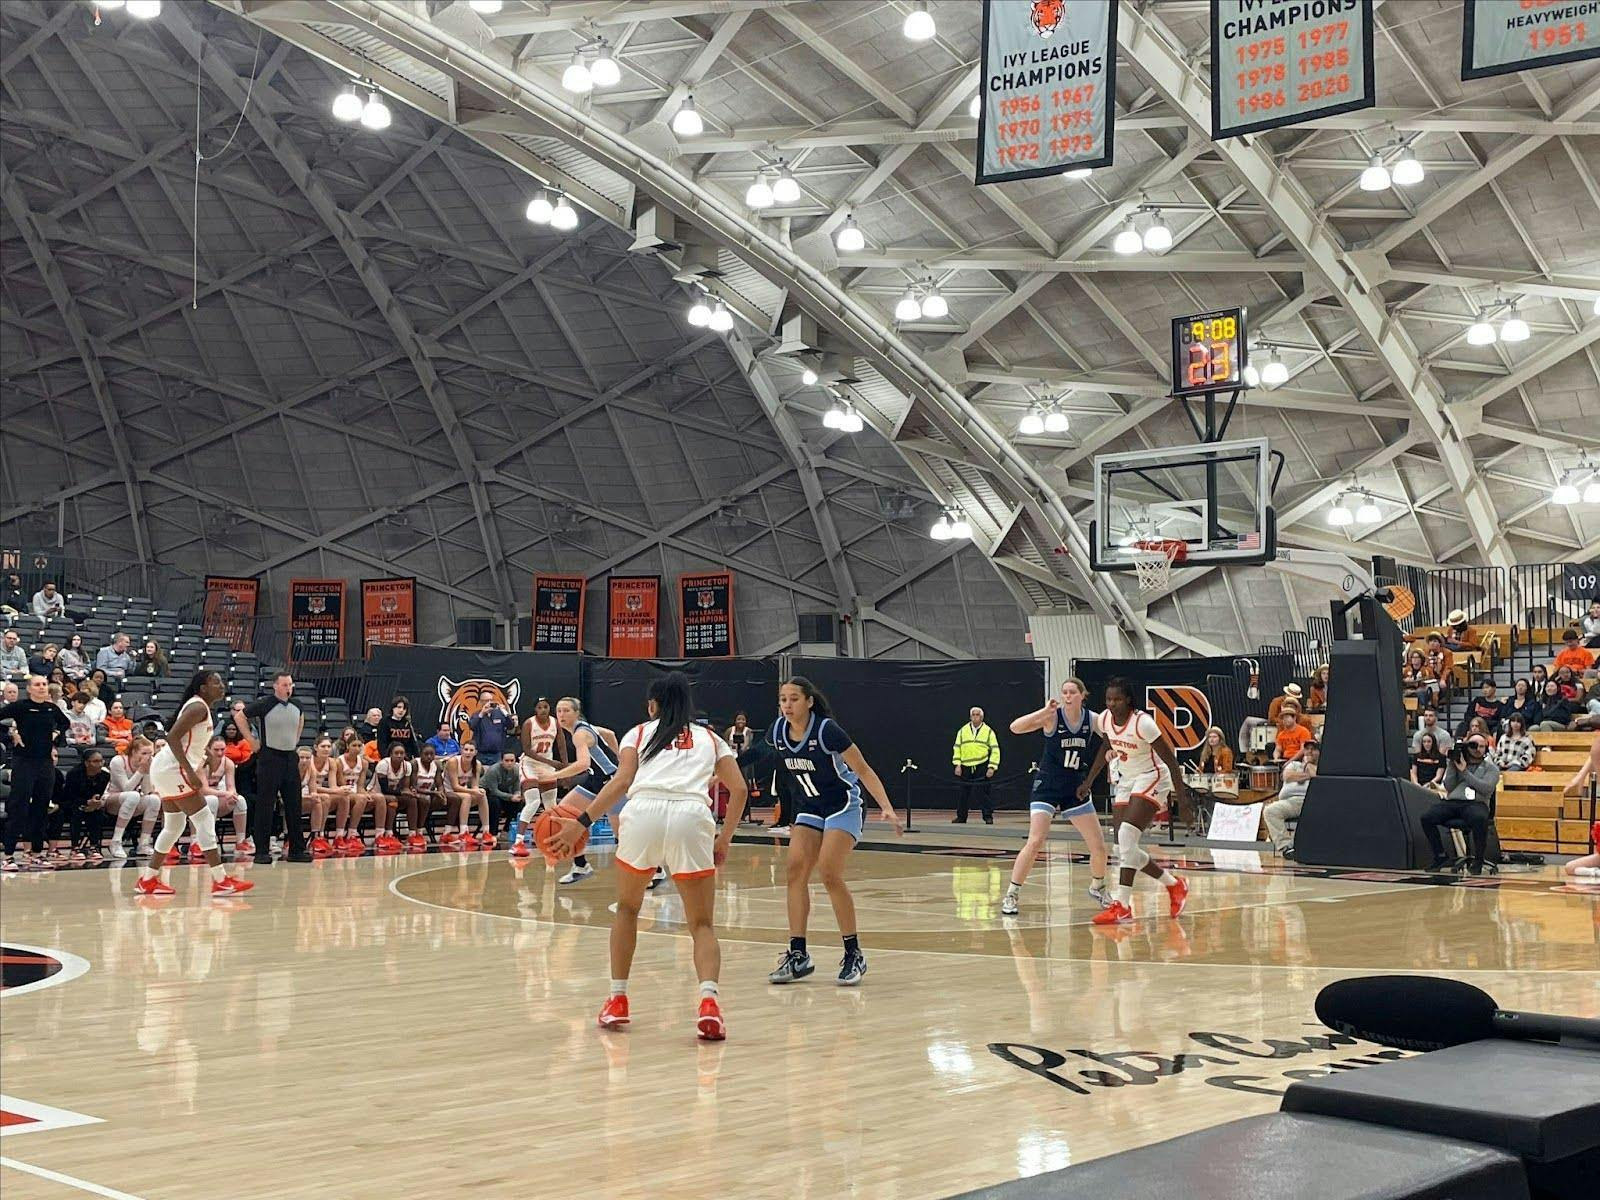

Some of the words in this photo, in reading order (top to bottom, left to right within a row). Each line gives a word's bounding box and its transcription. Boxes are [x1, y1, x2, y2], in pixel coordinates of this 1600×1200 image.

[1224, 0, 1356, 39] CHAMPIONS
[1506, 2, 1600, 29] HEAVYWEIGH
[1236, 36, 1285, 64] 1975
[1297, 20, 1348, 49] 1977
[1529, 22, 1585, 50] 1951
[1004, 52, 1027, 68] IVY
[1031, 40, 1090, 63] LEAGUE
[991, 57, 1102, 92] CHAMPIONS
[1236, 63, 1285, 90] 1978
[1298, 47, 1349, 75] 1985
[999, 94, 1041, 117] 1956
[1052, 84, 1094, 108] 1967
[1237, 88, 1286, 115] 1986
[1297, 74, 1349, 103] 2020
[998, 118, 1040, 141] 1970
[997, 142, 1039, 167] 1972
[1050, 133, 1093, 156] 1973
[1192, 316, 1236, 342] 9:08
[1188, 342, 1230, 385] 23
[209, 581, 255, 590] PRINCETON
[294, 585, 340, 593] PRINCETON
[366, 584, 411, 592] PRINCETON
[538, 580, 581, 588] PRINCETON
[612, 582, 656, 590] PRINCETON
[683, 578, 728, 587] PRINCETON
[1570, 575, 1597, 590] 109
[293, 621, 339, 629] CHAMPIONS
[366, 619, 411, 628] CHAMPIONS
[536, 616, 578, 625] CHAMPIONS
[684, 615, 728, 624] CHAMPIONS
[1064, 750, 1081, 770] 14
[796, 772, 821, 797] 11
